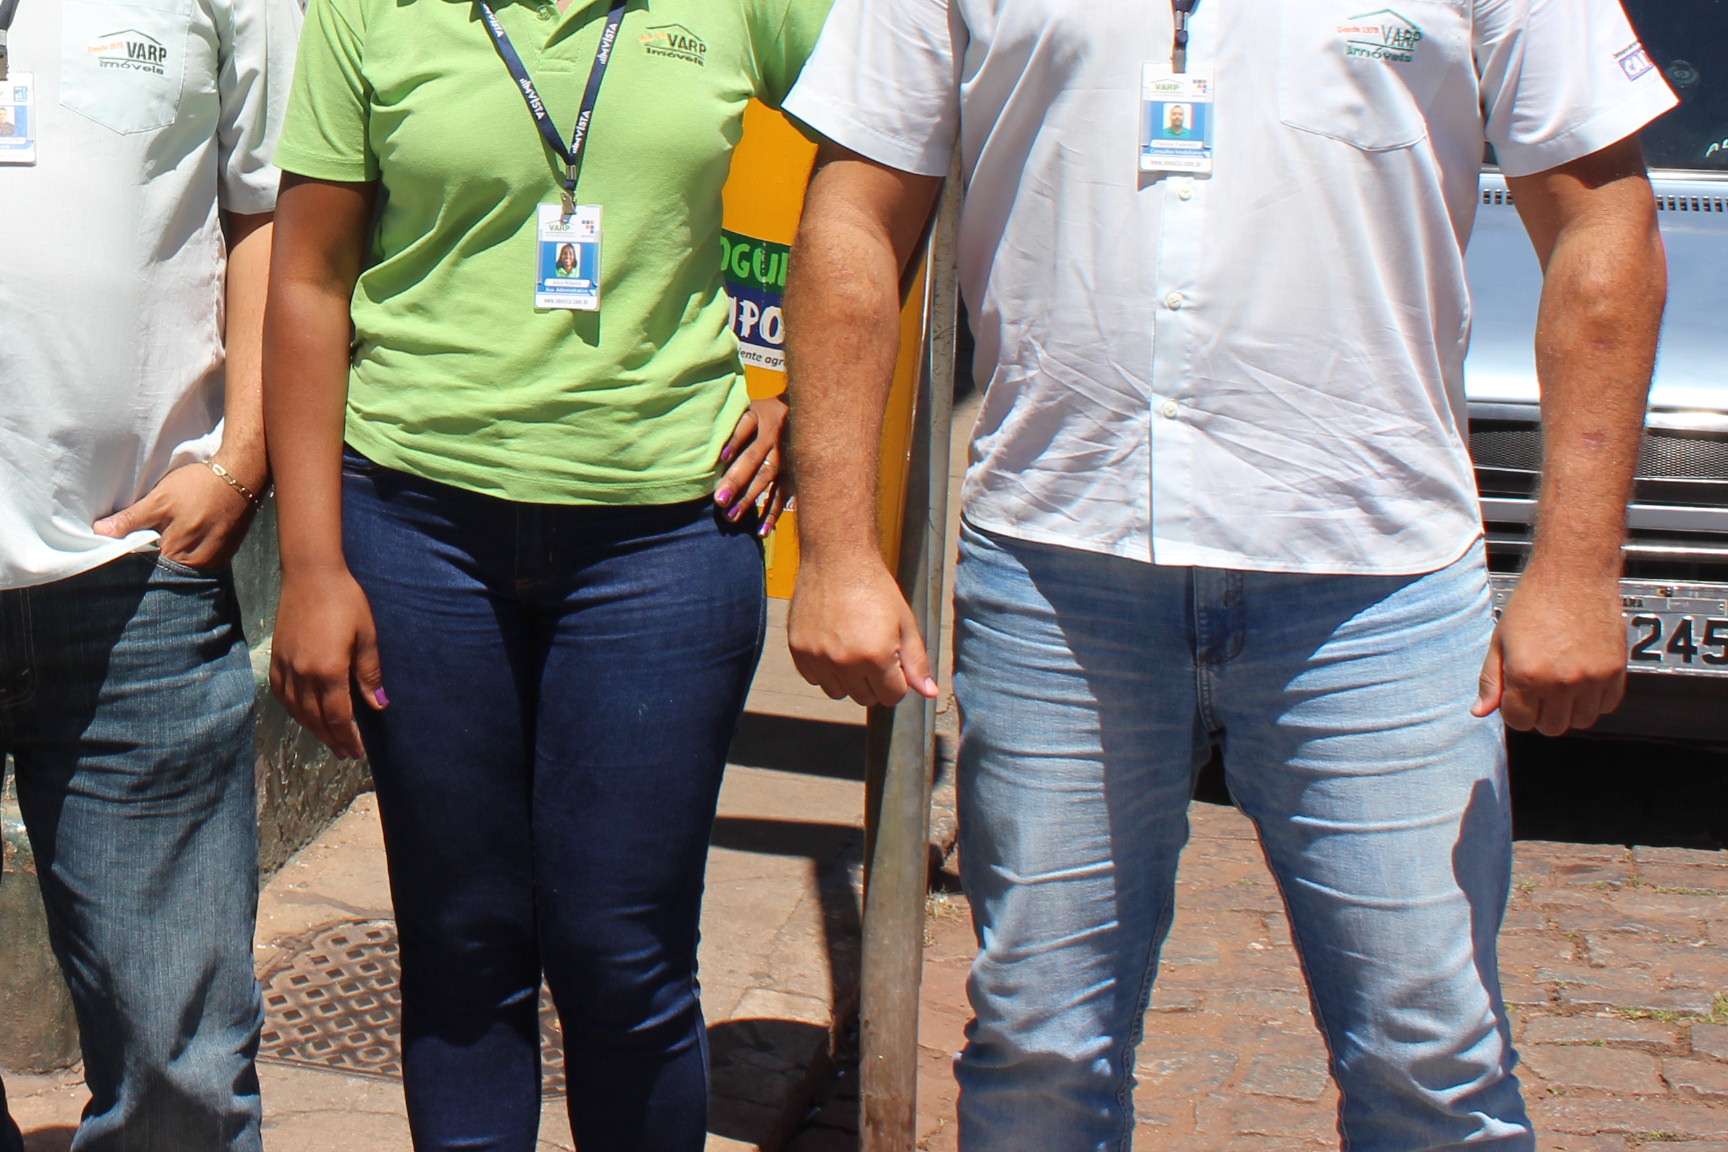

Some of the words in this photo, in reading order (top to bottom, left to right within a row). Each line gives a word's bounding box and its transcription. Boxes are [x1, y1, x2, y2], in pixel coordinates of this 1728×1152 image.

[666, 32, 707, 55] VARP
[1380, 23, 1422, 49] VARP
[126, 40, 168, 63] VARP
[1154, 83, 1180, 91] VARP
